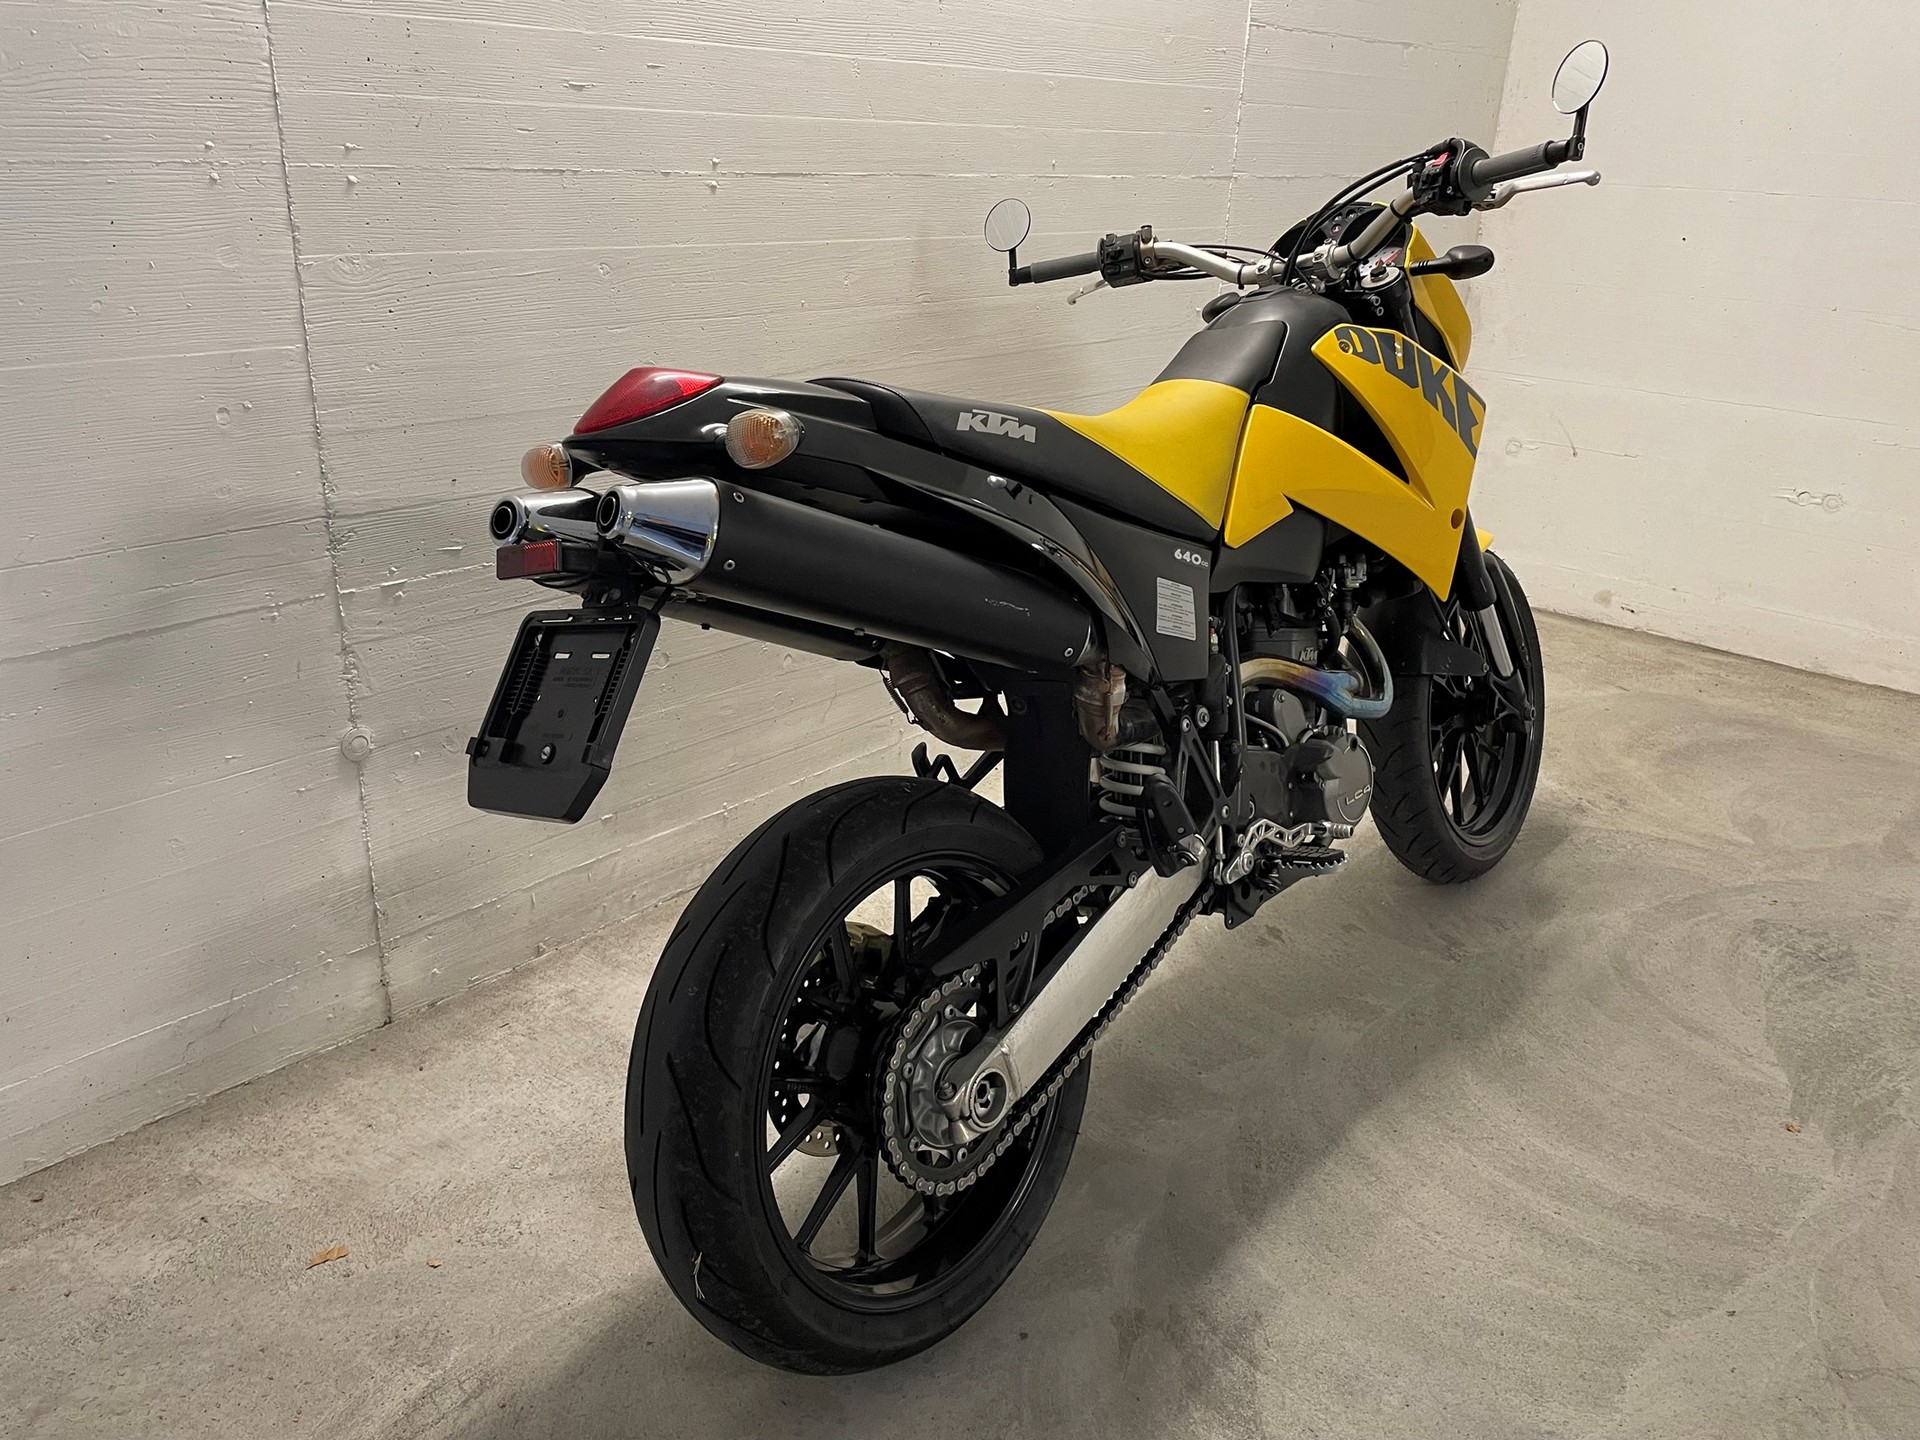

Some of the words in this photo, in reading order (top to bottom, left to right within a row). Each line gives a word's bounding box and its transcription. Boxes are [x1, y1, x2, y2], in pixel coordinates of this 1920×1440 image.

[1334, 327, 1486, 460] DUKE
[956, 408, 1036, 443] KTM
[1299, 647, 1318, 661] KTM
[1346, 784, 1371, 805] LC4
